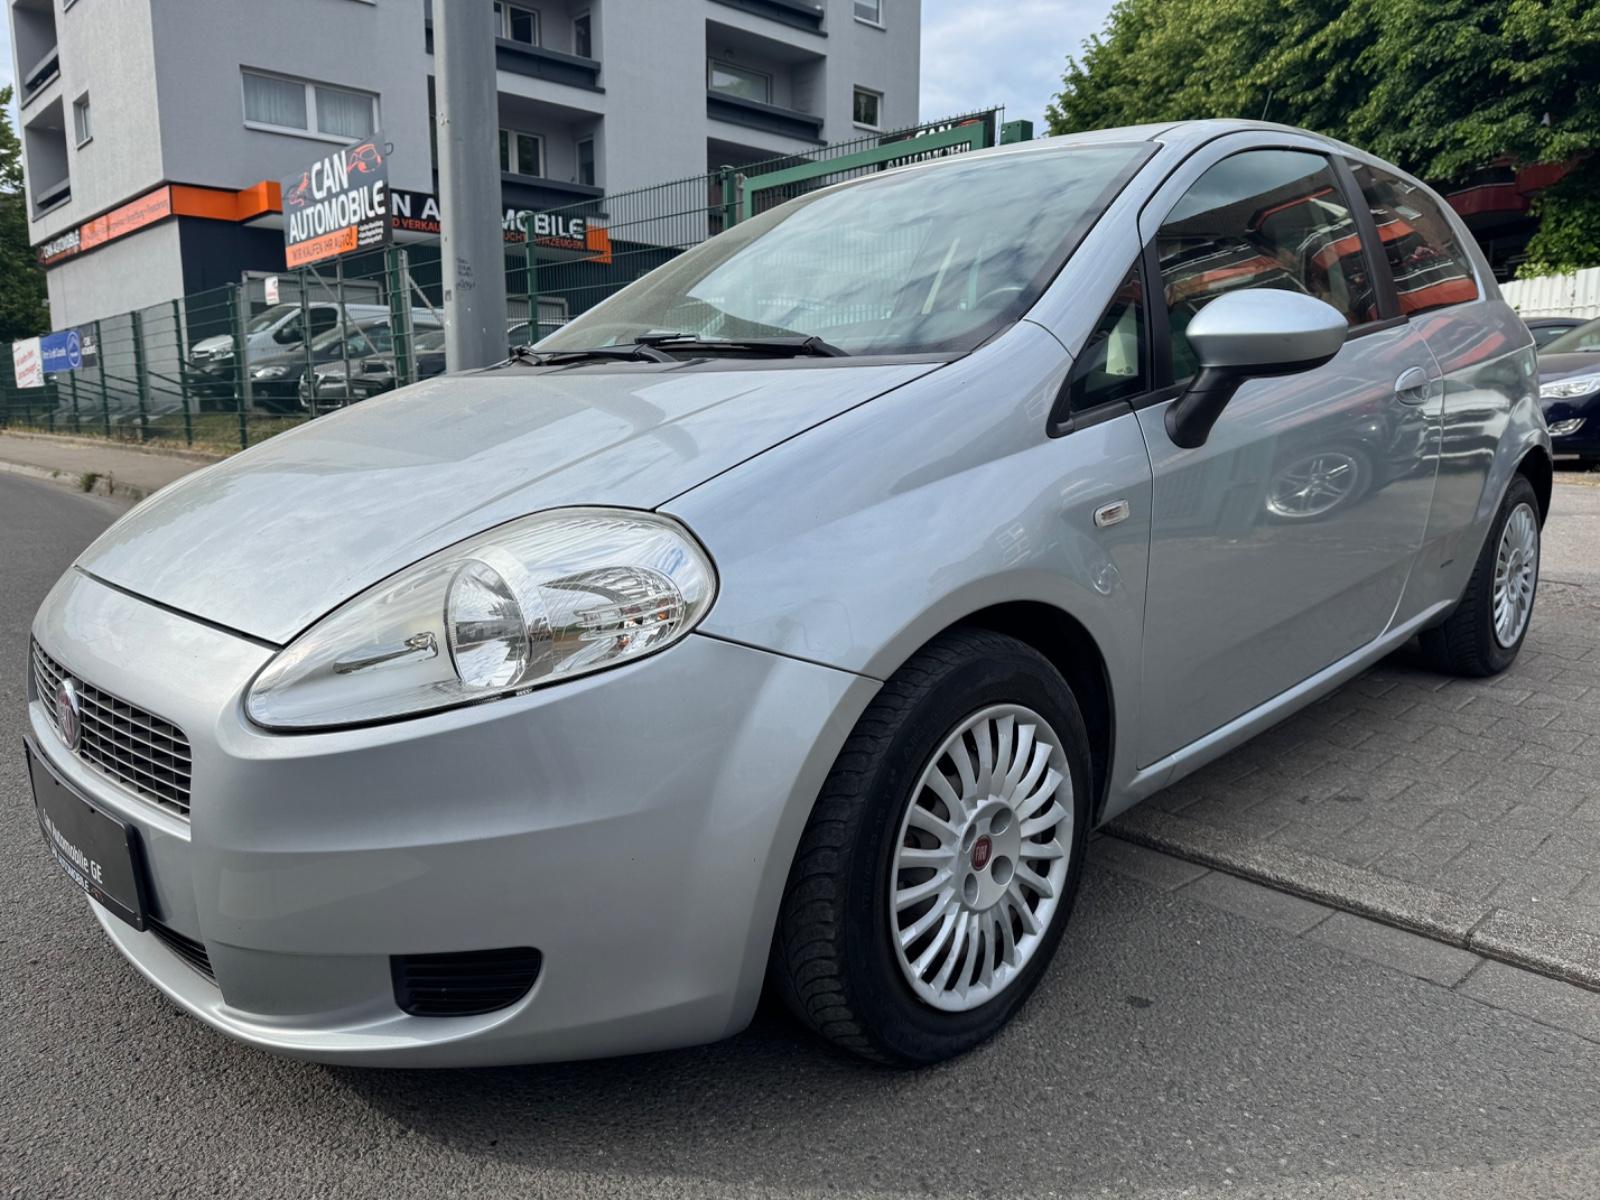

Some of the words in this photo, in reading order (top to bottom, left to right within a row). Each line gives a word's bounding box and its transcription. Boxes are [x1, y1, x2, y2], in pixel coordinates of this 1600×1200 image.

[311, 150, 349, 200] CAN
[289, 179, 386, 244] AUTOMOBILE
[52, 821, 89, 873] Automobile
[90, 859, 103, 884] GE
